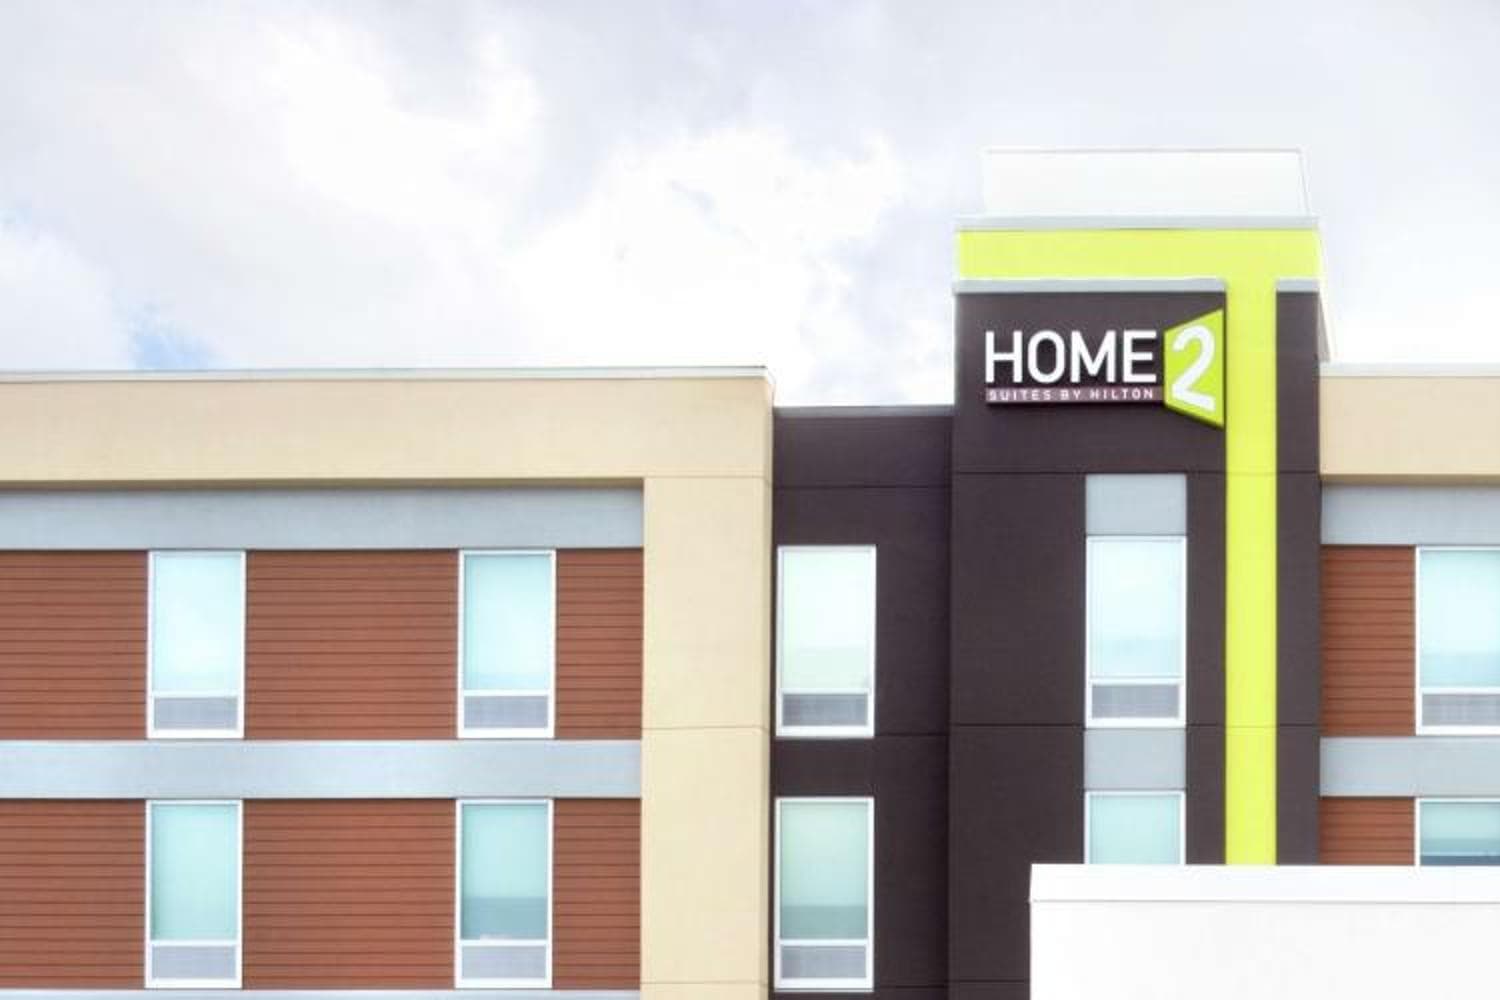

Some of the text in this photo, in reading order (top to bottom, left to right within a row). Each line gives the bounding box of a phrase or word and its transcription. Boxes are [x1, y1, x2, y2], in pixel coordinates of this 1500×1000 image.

[985, 330, 1157, 384] HOME
[988, 387, 1154, 401] SUITES BY HILTON
